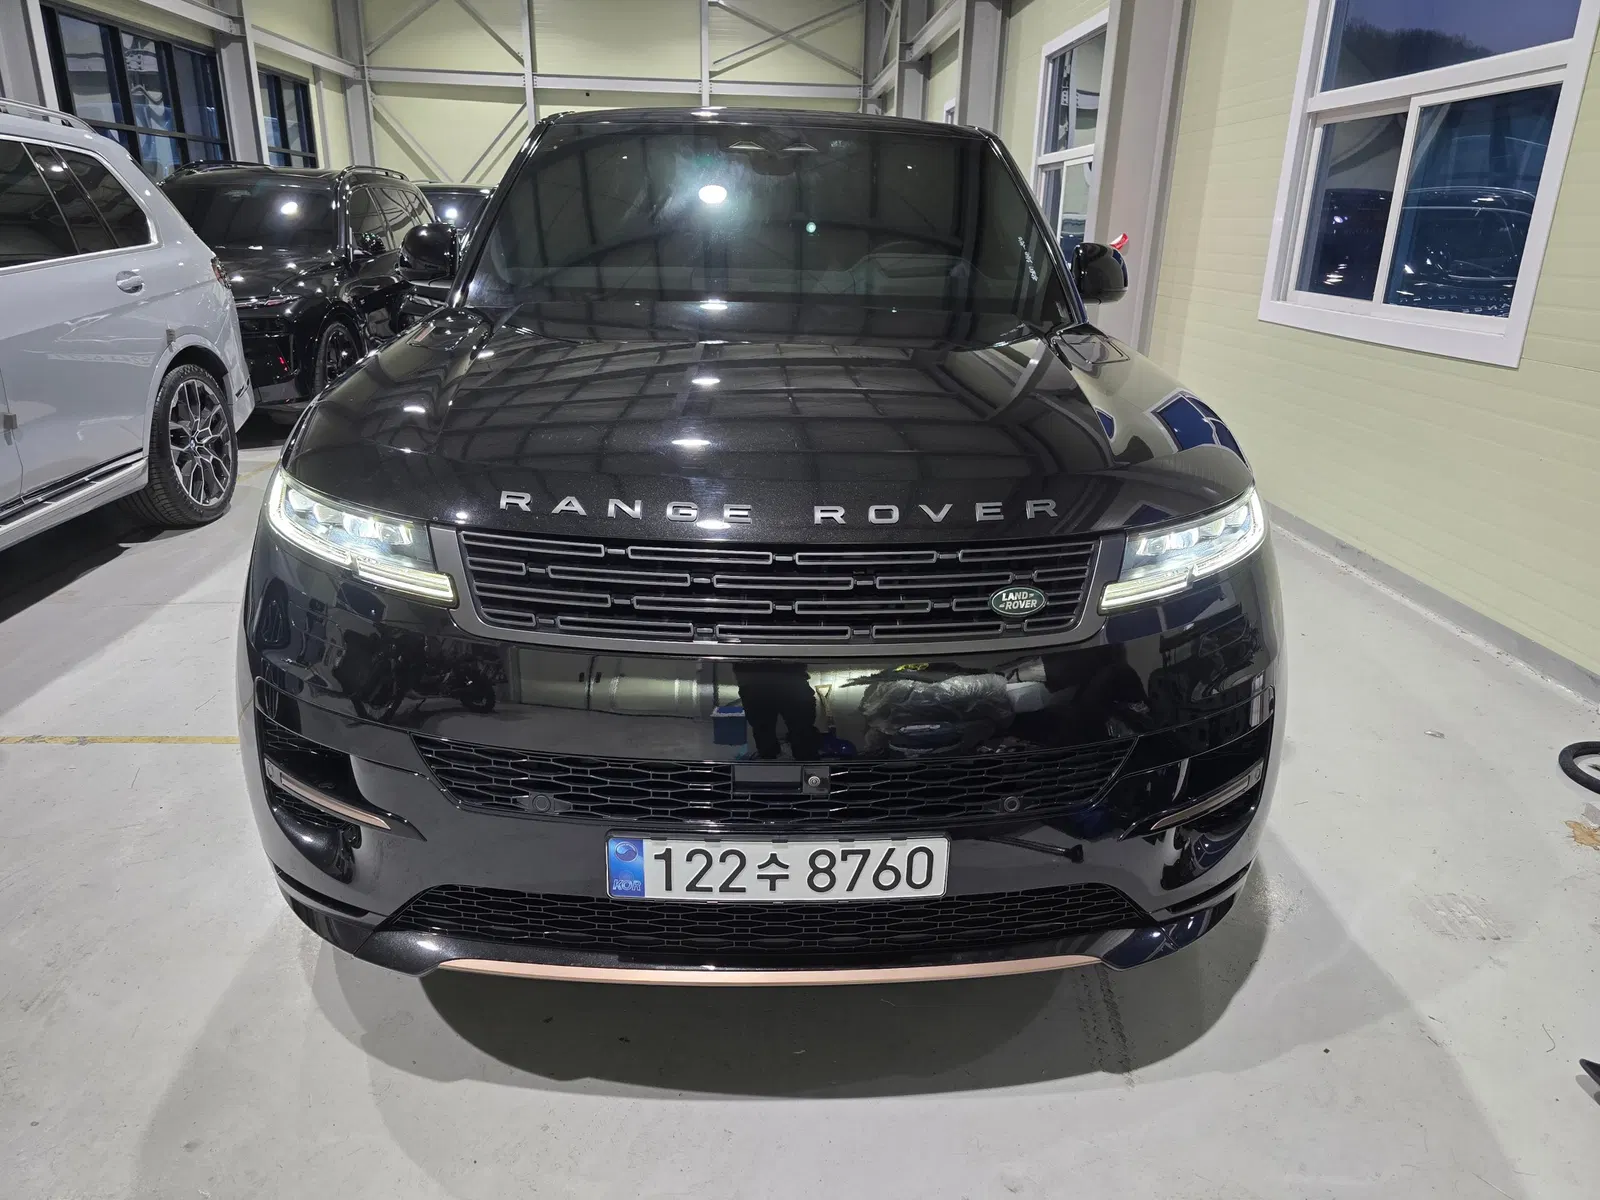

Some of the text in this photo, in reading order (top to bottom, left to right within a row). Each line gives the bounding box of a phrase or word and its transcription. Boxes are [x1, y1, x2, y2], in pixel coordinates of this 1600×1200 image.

[499, 490, 1059, 525] RANGE ROVER
[1002, 591, 1028, 601] LAND
[1005, 599, 1037, 610] ROVER
[653, 846, 935, 893] 122수 8760
[612, 878, 642, 892] KOR
